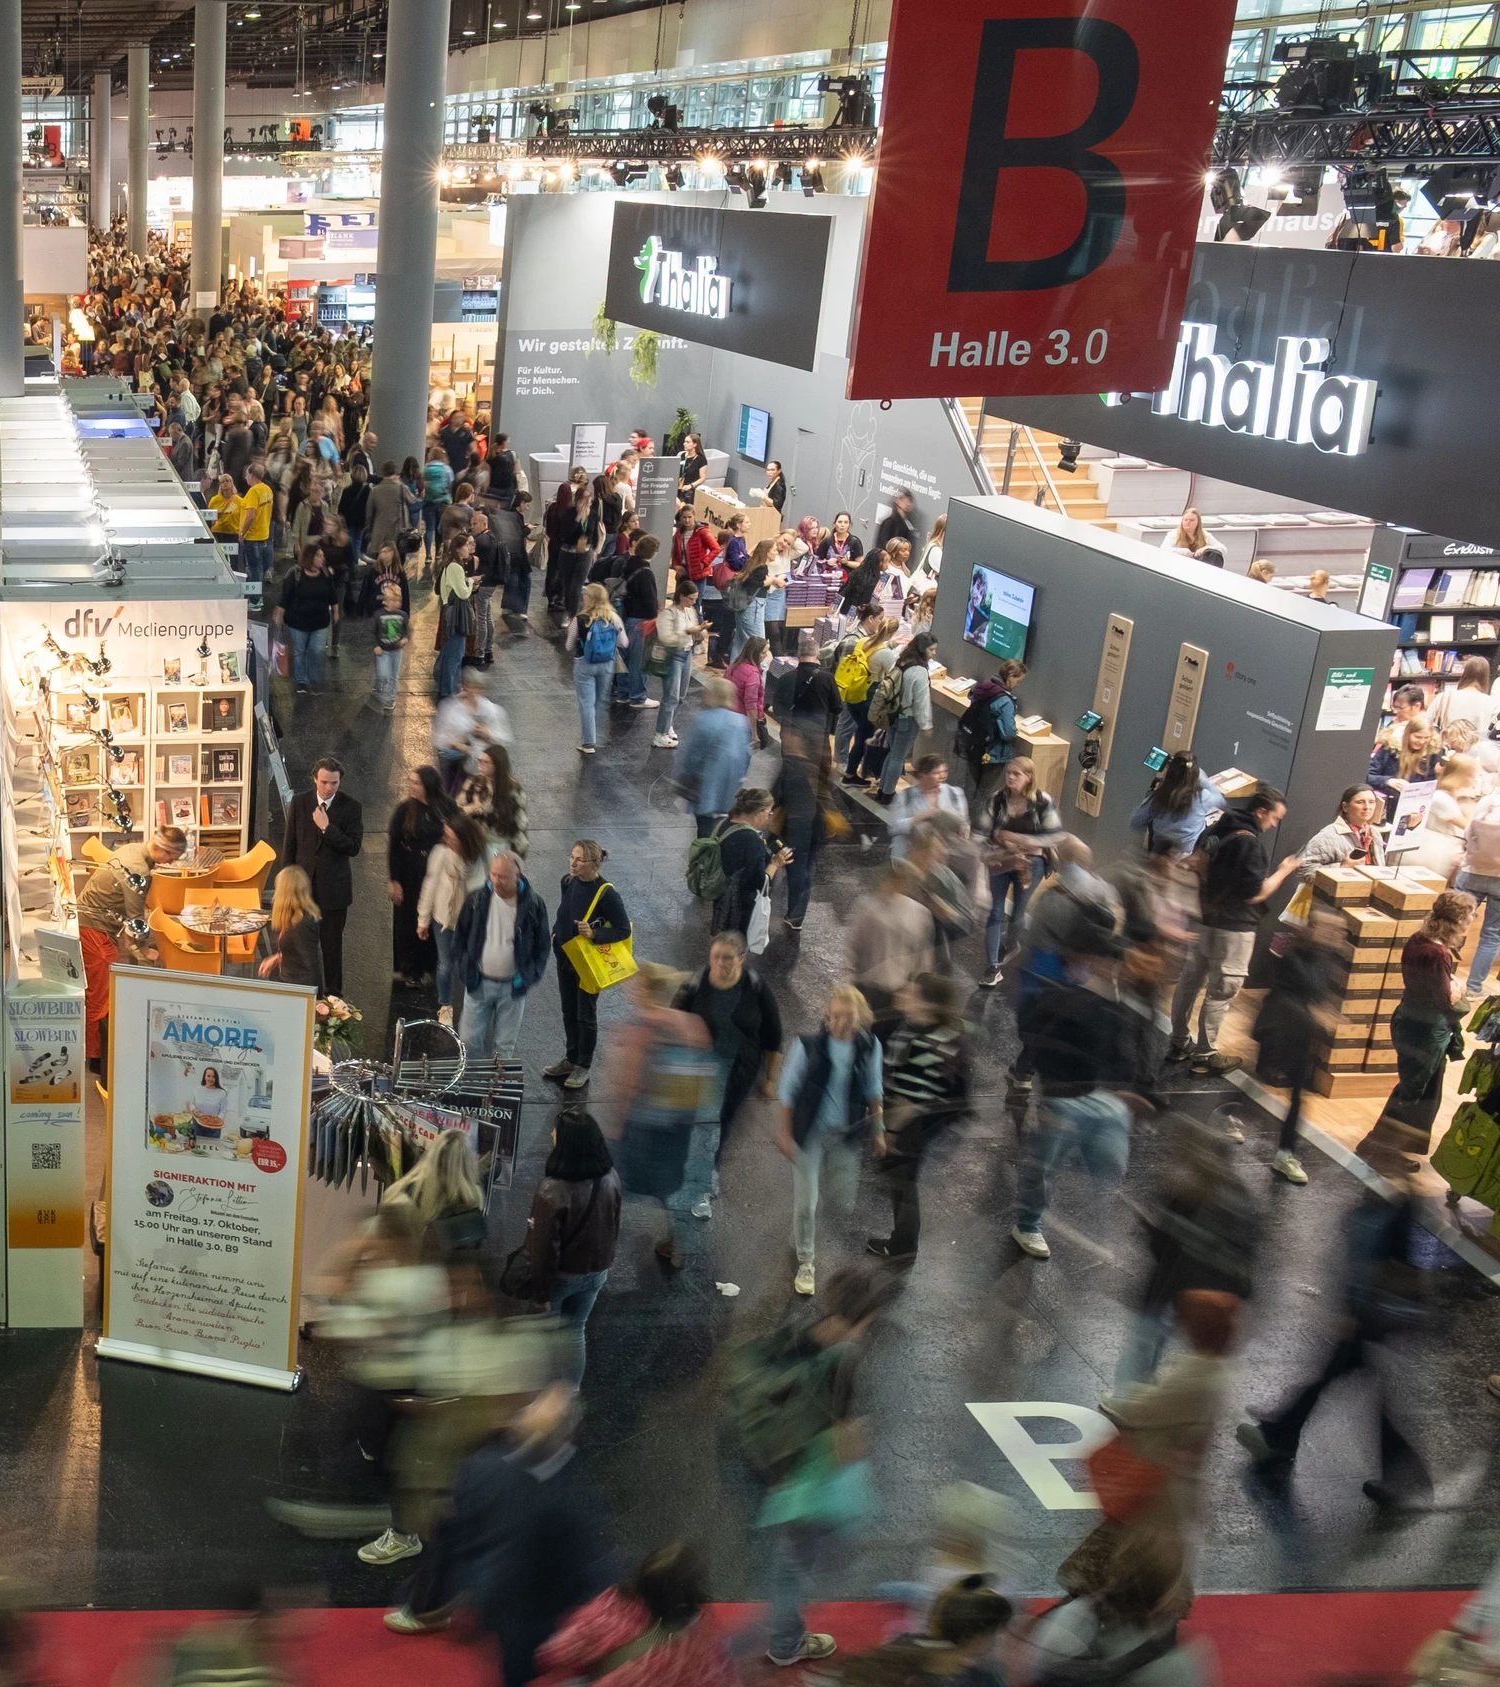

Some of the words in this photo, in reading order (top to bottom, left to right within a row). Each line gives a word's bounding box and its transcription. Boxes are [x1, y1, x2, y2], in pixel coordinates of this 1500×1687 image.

[947, 17, 1141, 293] B
[657, 249, 731, 319] Thalia
[519, 339, 546, 352] Wir
[930, 331, 1031, 368] Halle
[1044, 328, 1109, 366] 3.0
[518, 367, 532, 375] Für
[534, 366, 563, 375] Kultur.
[516, 377, 531, 385] Für
[533, 376, 580, 385] Menschen.
[516, 387, 531, 395] Für
[532, 387, 555, 395] Dich.
[64, 608, 114, 638] dfv
[118, 622, 234, 640] Mediengruppe
[1235, 672, 1246, 683] story
[1234, 741, 1240, 755] 1
[9, 1001, 82, 1015] SLOWBURN
[15, 1030, 77, 1042] SLOWBURN
[162, 1021, 258, 1048] AMORE
[419, 1126, 435, 1141] CAR
[258, 1157, 269, 1167] EUR
[153, 1170, 235, 1190] SIGNIERAKTION
[238, 1183, 256, 1193] MIT
[146, 1210, 162, 1218] am
[203, 1218, 215, 1227] 17.
[218, 1220, 260, 1235] Oktober,
[134, 1220, 159, 1230] 15.00
[162, 1223, 180, 1233] Uhr
[197, 1230, 240, 1243] unserem
[243, 1235, 272, 1248] Stand
[166, 1234, 176, 1243] in
[177, 1236, 203, 1248] Halle
[226, 1244, 239, 1253] B9
[211, 1273, 244, 1284] nimmt
[232, 1286, 256, 1298] Reise
[258, 1290, 288, 1304] durch
